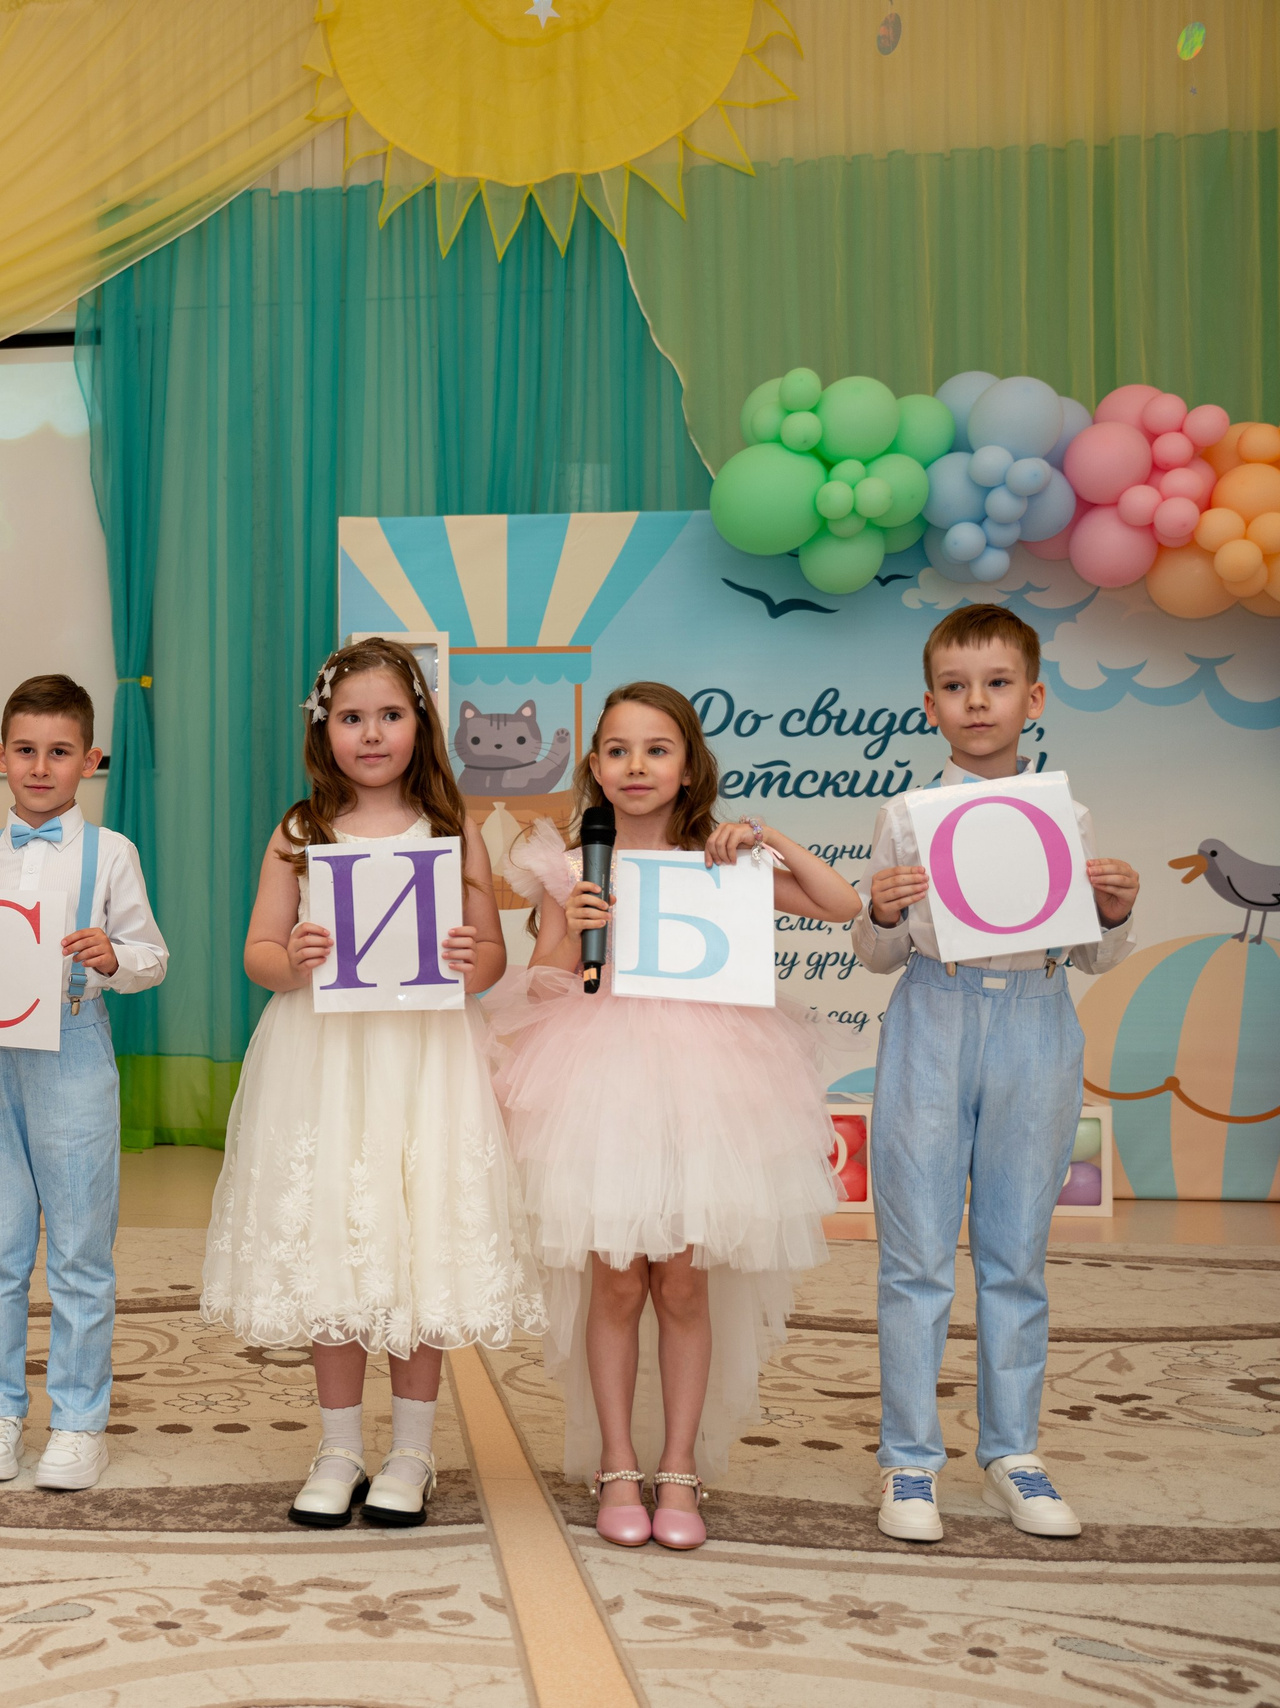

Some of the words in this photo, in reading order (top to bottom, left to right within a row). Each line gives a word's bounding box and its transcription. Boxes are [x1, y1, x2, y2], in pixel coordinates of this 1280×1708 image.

[690, 687, 774, 738] До
[719, 759, 915, 799] етский
[929, 795, 1073, 935] О
[312, 849, 460, 991] И
[618, 857, 730, 980] Б
[803, 951, 864, 984] дру
